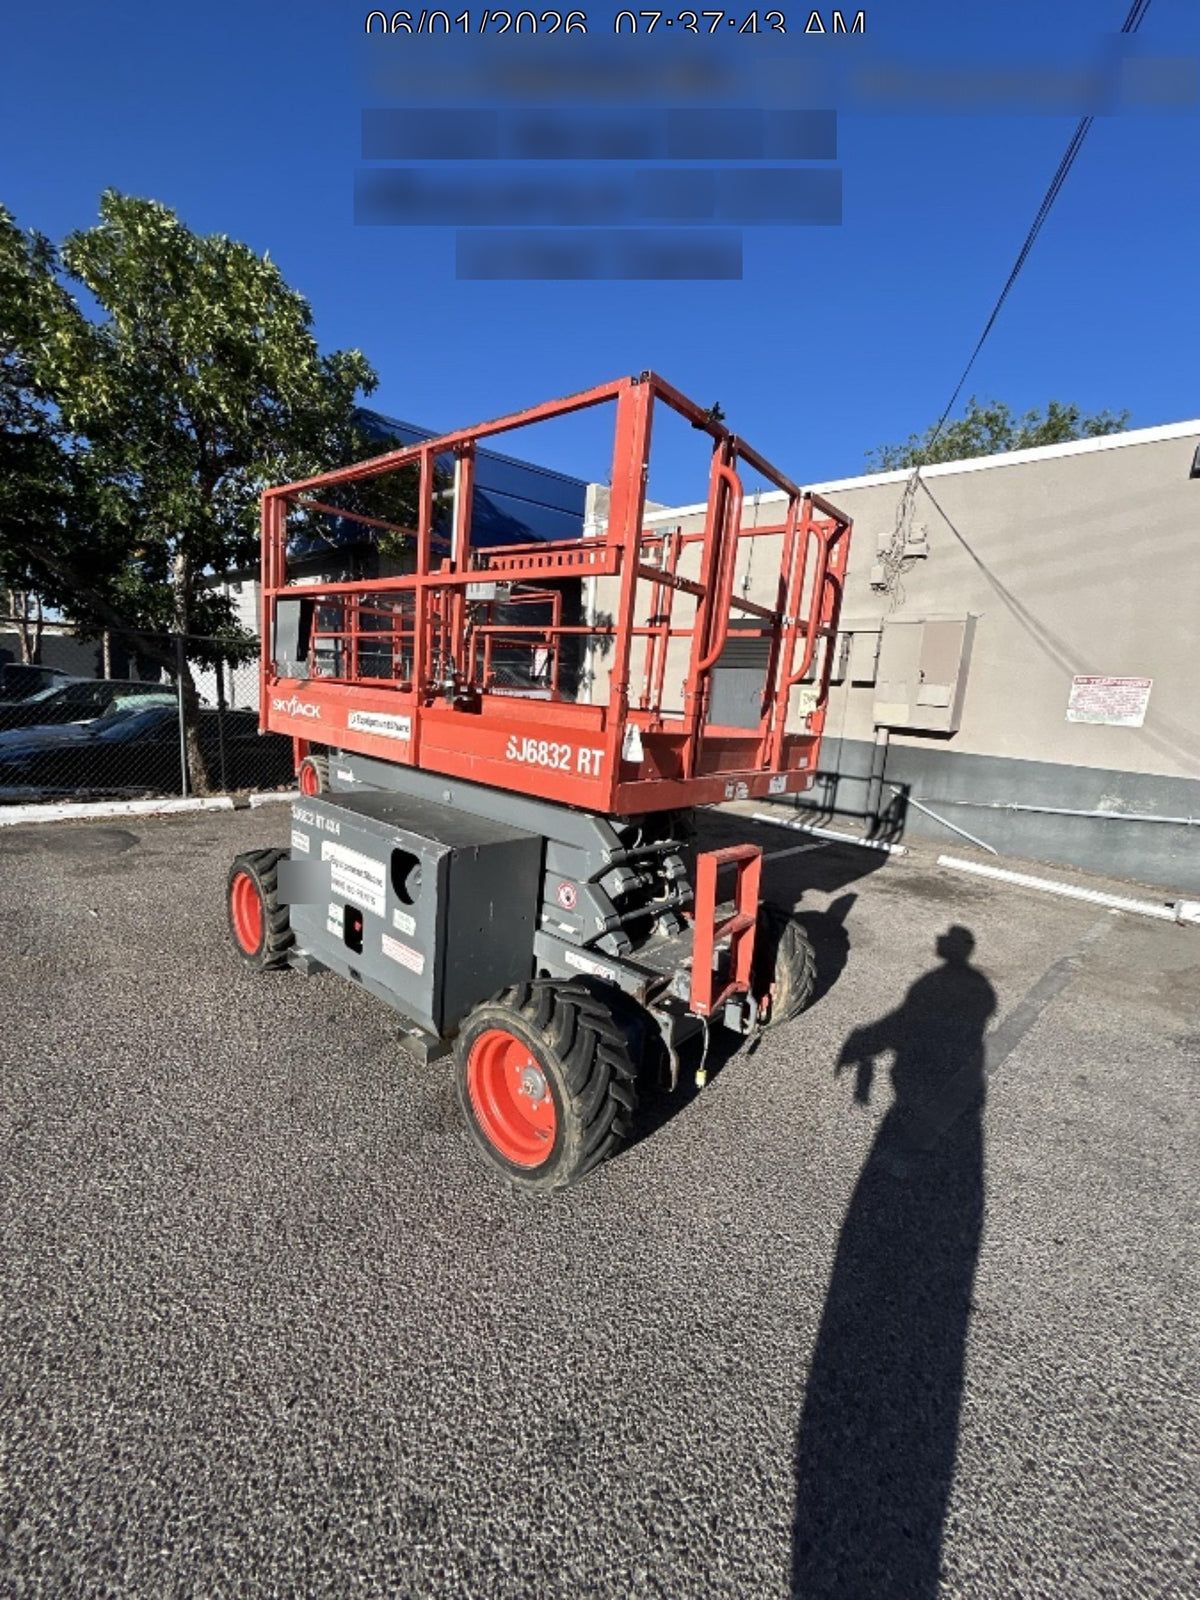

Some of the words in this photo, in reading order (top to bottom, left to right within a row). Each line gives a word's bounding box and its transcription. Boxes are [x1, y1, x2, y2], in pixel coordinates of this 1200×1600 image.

[272, 695, 321, 718] SKYJACK
[506, 735, 571, 770] SJ6832
[577, 747, 605, 776] RT
